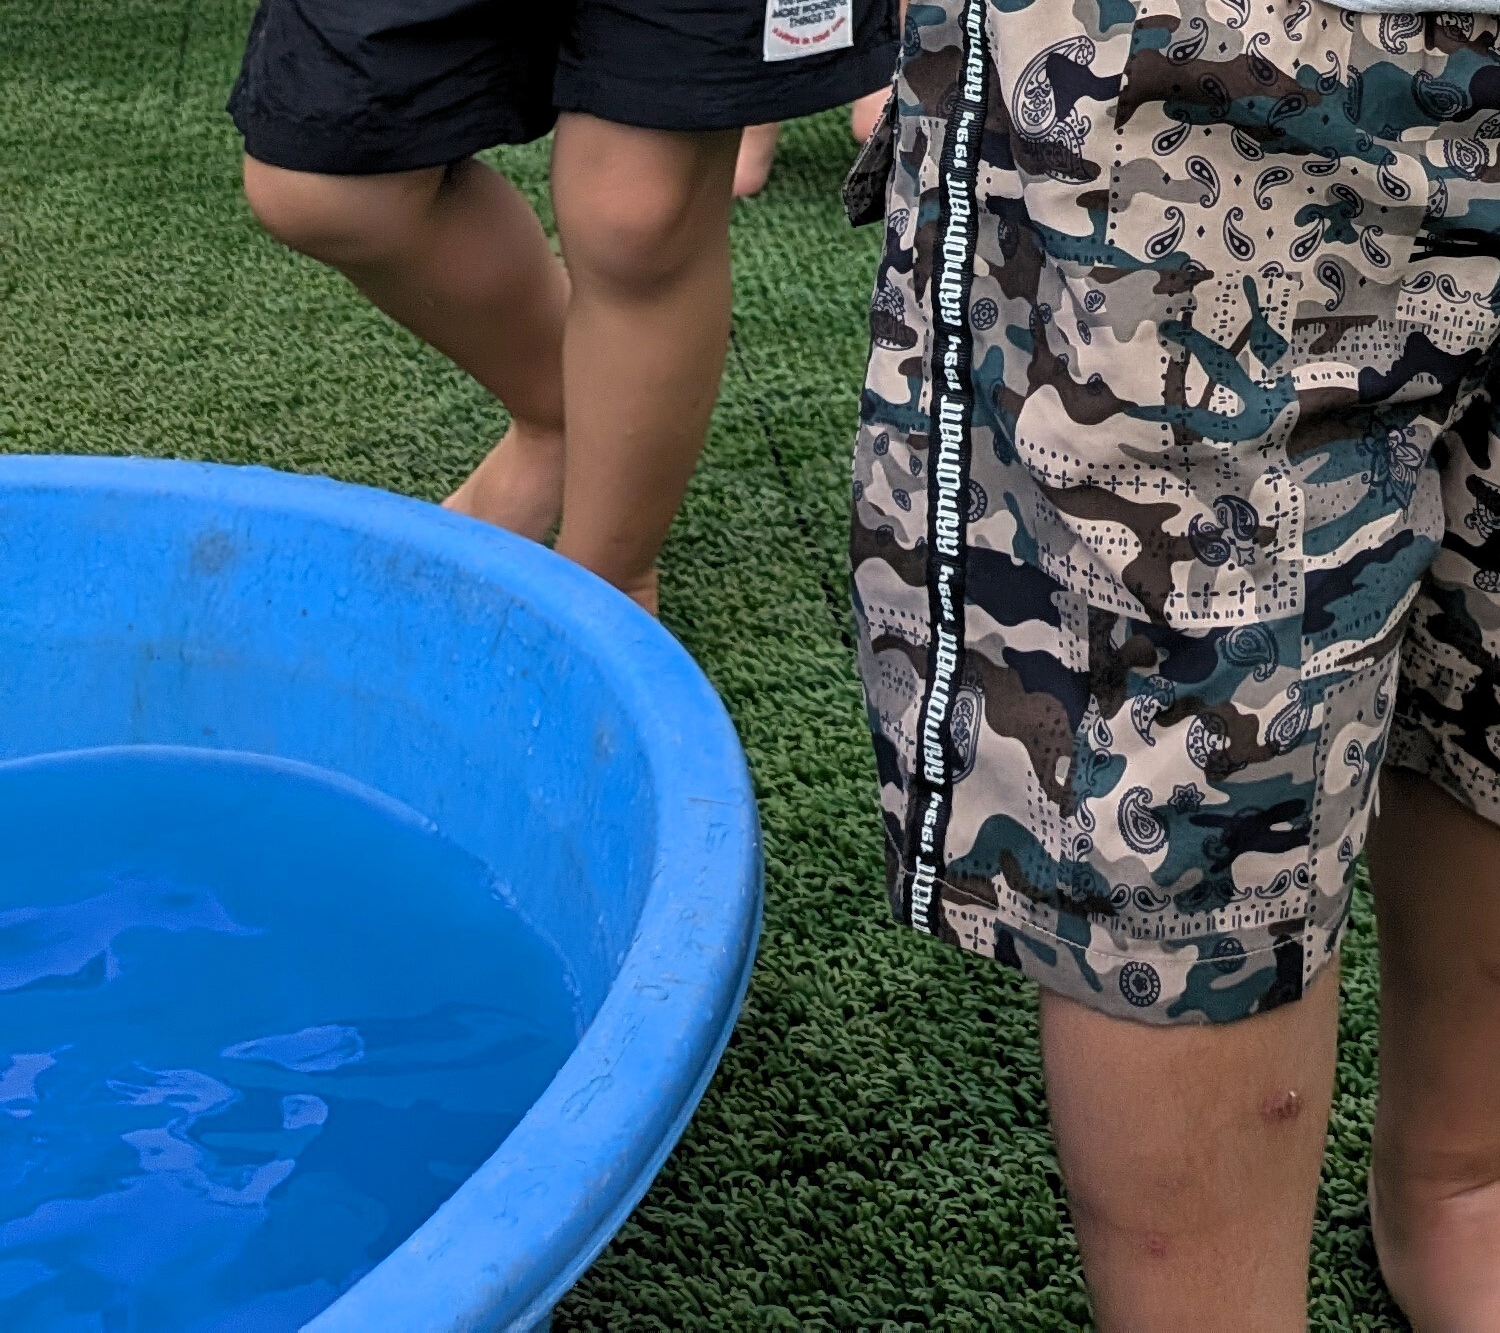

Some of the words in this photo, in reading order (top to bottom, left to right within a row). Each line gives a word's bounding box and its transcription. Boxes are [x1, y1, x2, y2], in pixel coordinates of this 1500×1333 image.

[954, 112, 974, 169] 1994
[944, 335, 962, 391] 1994
[937, 565, 955, 622] 1994
[920, 792, 943, 853] 1994
